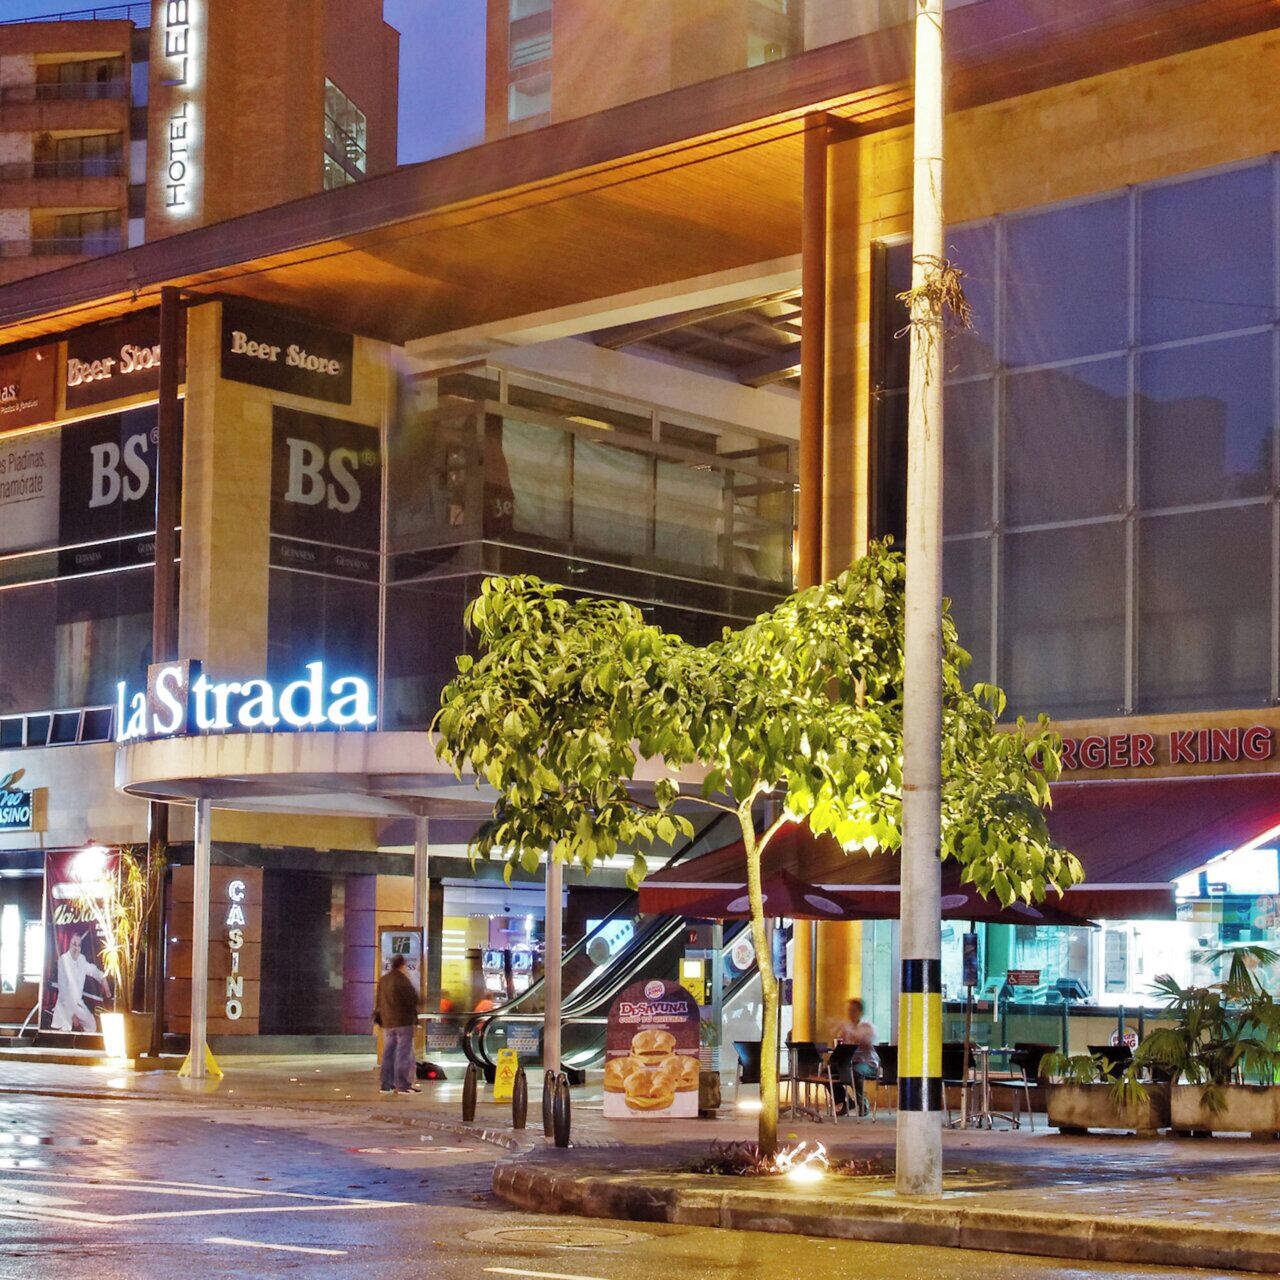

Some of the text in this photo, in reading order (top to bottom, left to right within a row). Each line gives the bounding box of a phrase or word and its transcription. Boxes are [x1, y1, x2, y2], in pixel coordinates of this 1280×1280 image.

[166, 102, 187, 208] HOTEL
[67, 344, 161, 387] Beer Stor
[231, 331, 340, 375] Beer Store
[153, 661, 377, 735] Strada
[1029, 725, 1272, 770] RGER KING
[226, 880, 246, 1020] CASINO
